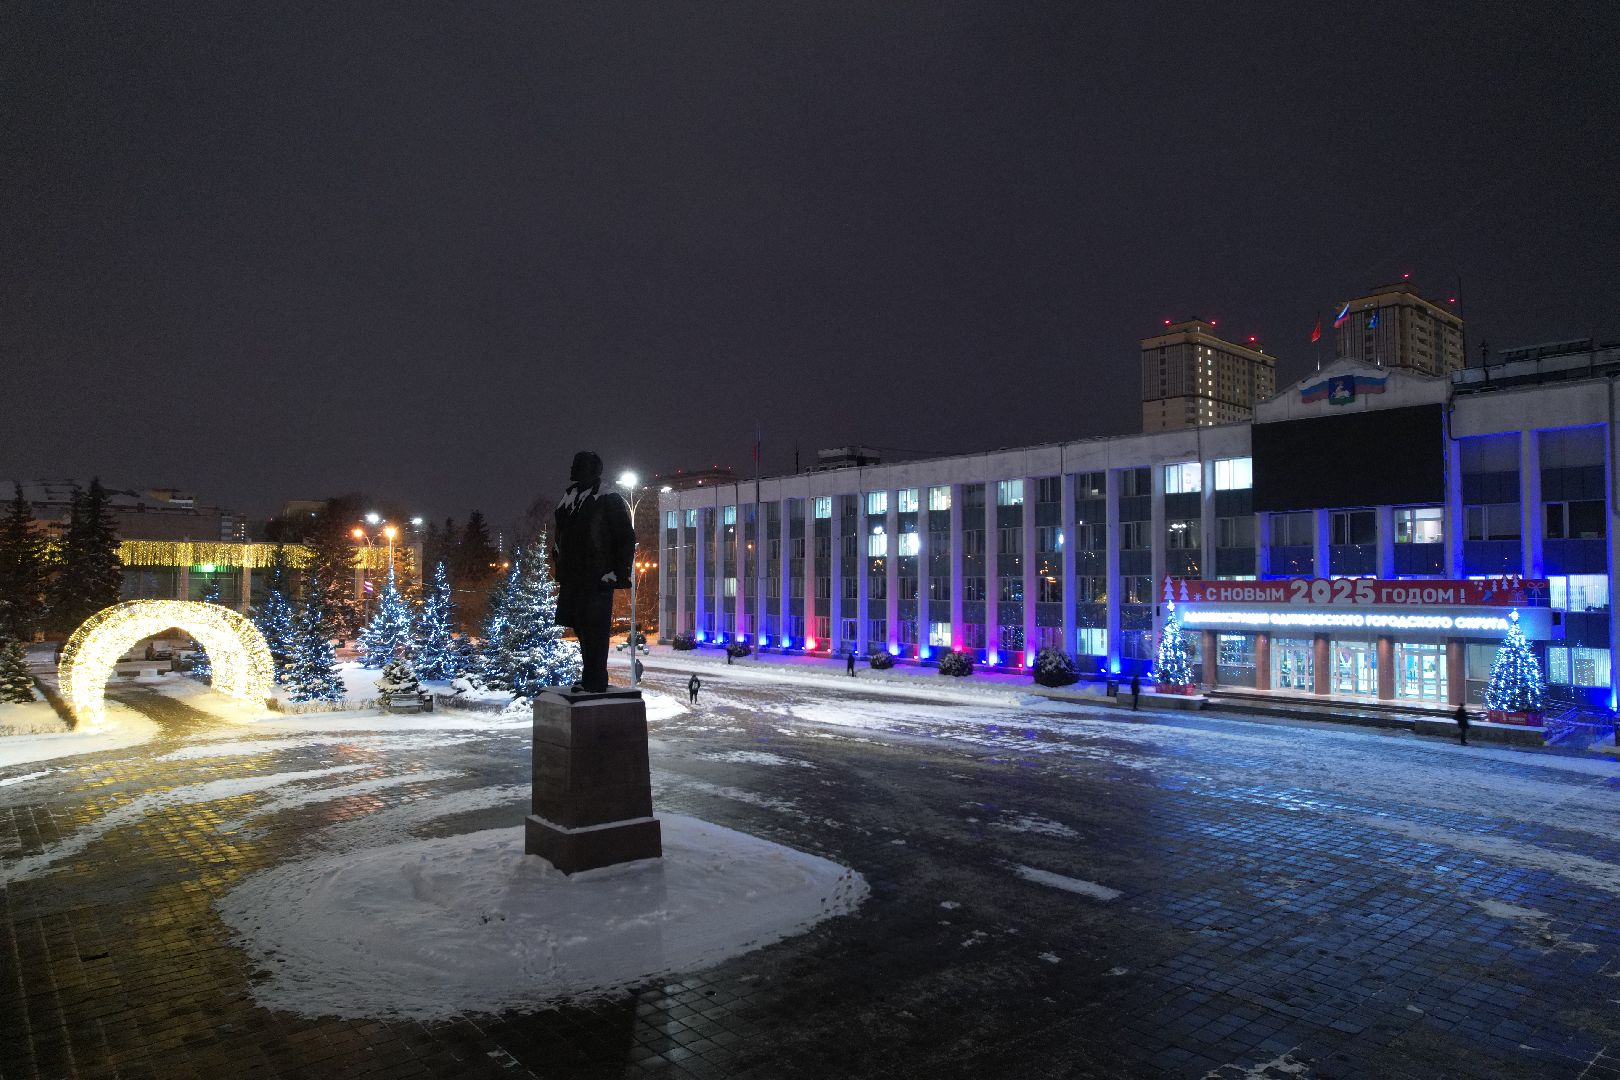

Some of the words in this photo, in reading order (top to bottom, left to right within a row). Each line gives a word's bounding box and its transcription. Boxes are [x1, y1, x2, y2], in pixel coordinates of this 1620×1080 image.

[1206, 588, 1216, 601] С
[1220, 588, 1284, 601] НОВЫМ
[1290, 579, 1376, 604] 2025
